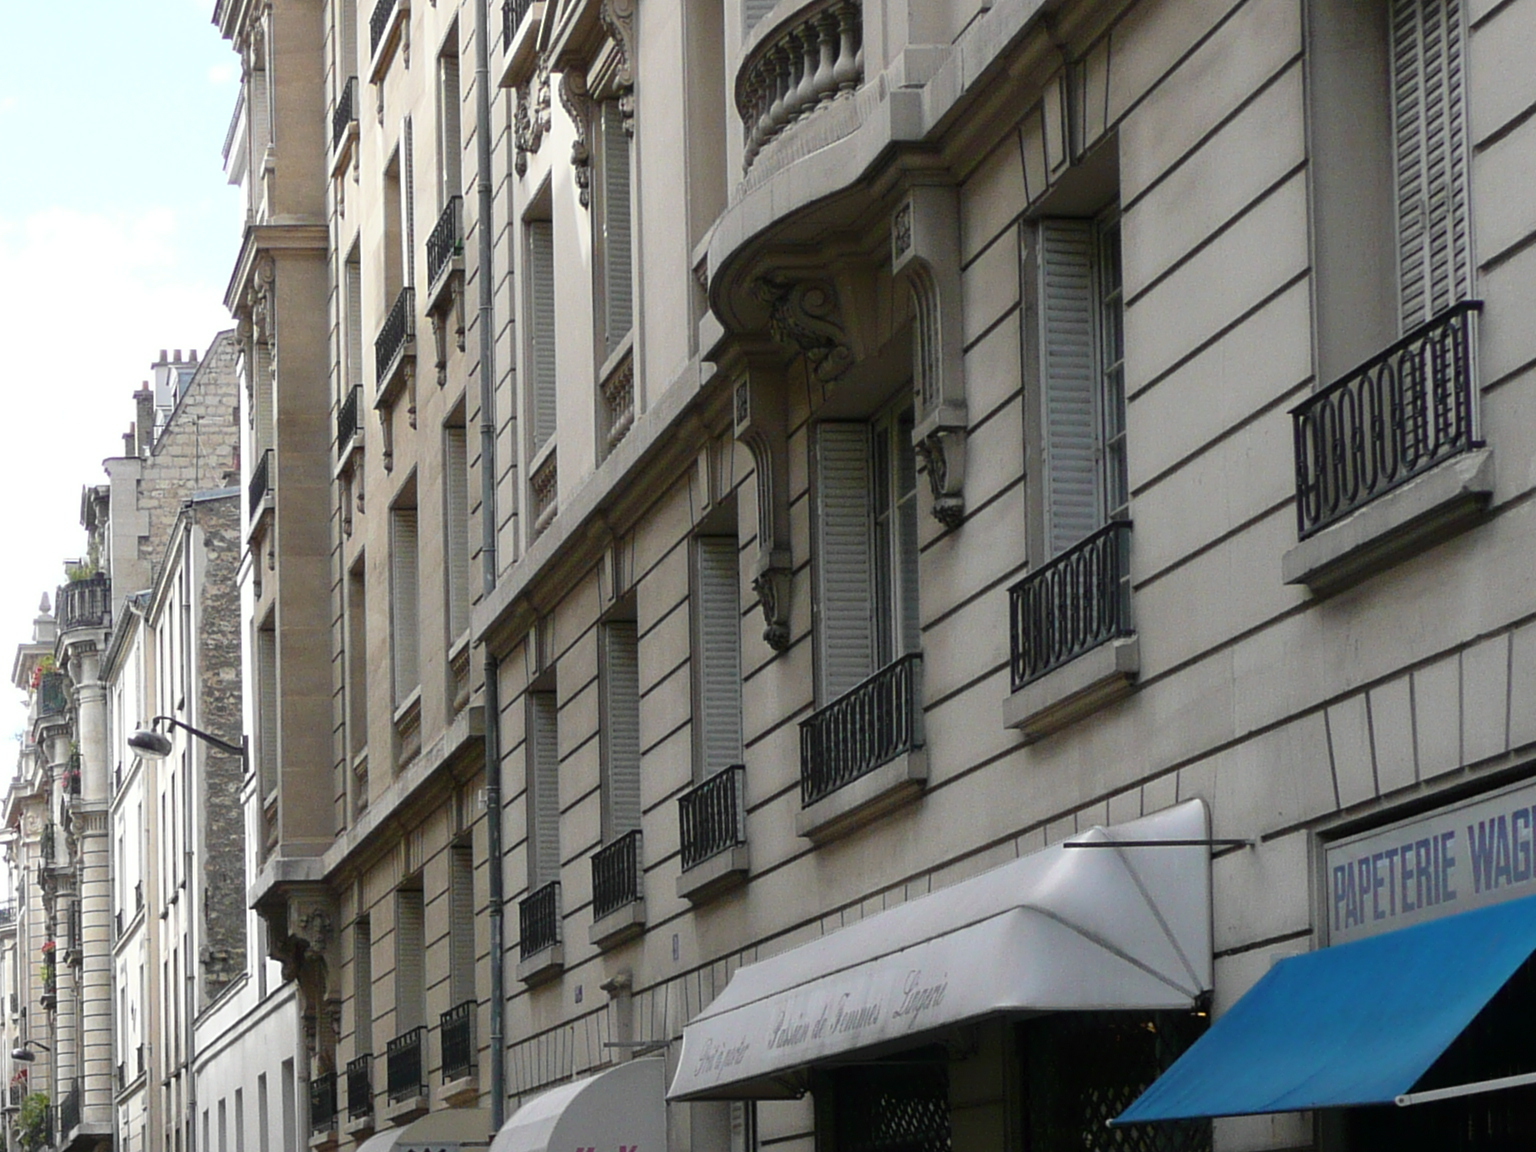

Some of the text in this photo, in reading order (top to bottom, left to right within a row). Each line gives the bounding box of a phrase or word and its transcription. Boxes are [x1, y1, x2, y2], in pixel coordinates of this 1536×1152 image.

[1333, 805, 1536, 931] PAPETERIE WAG
[813, 1003, 828, 1039] de
